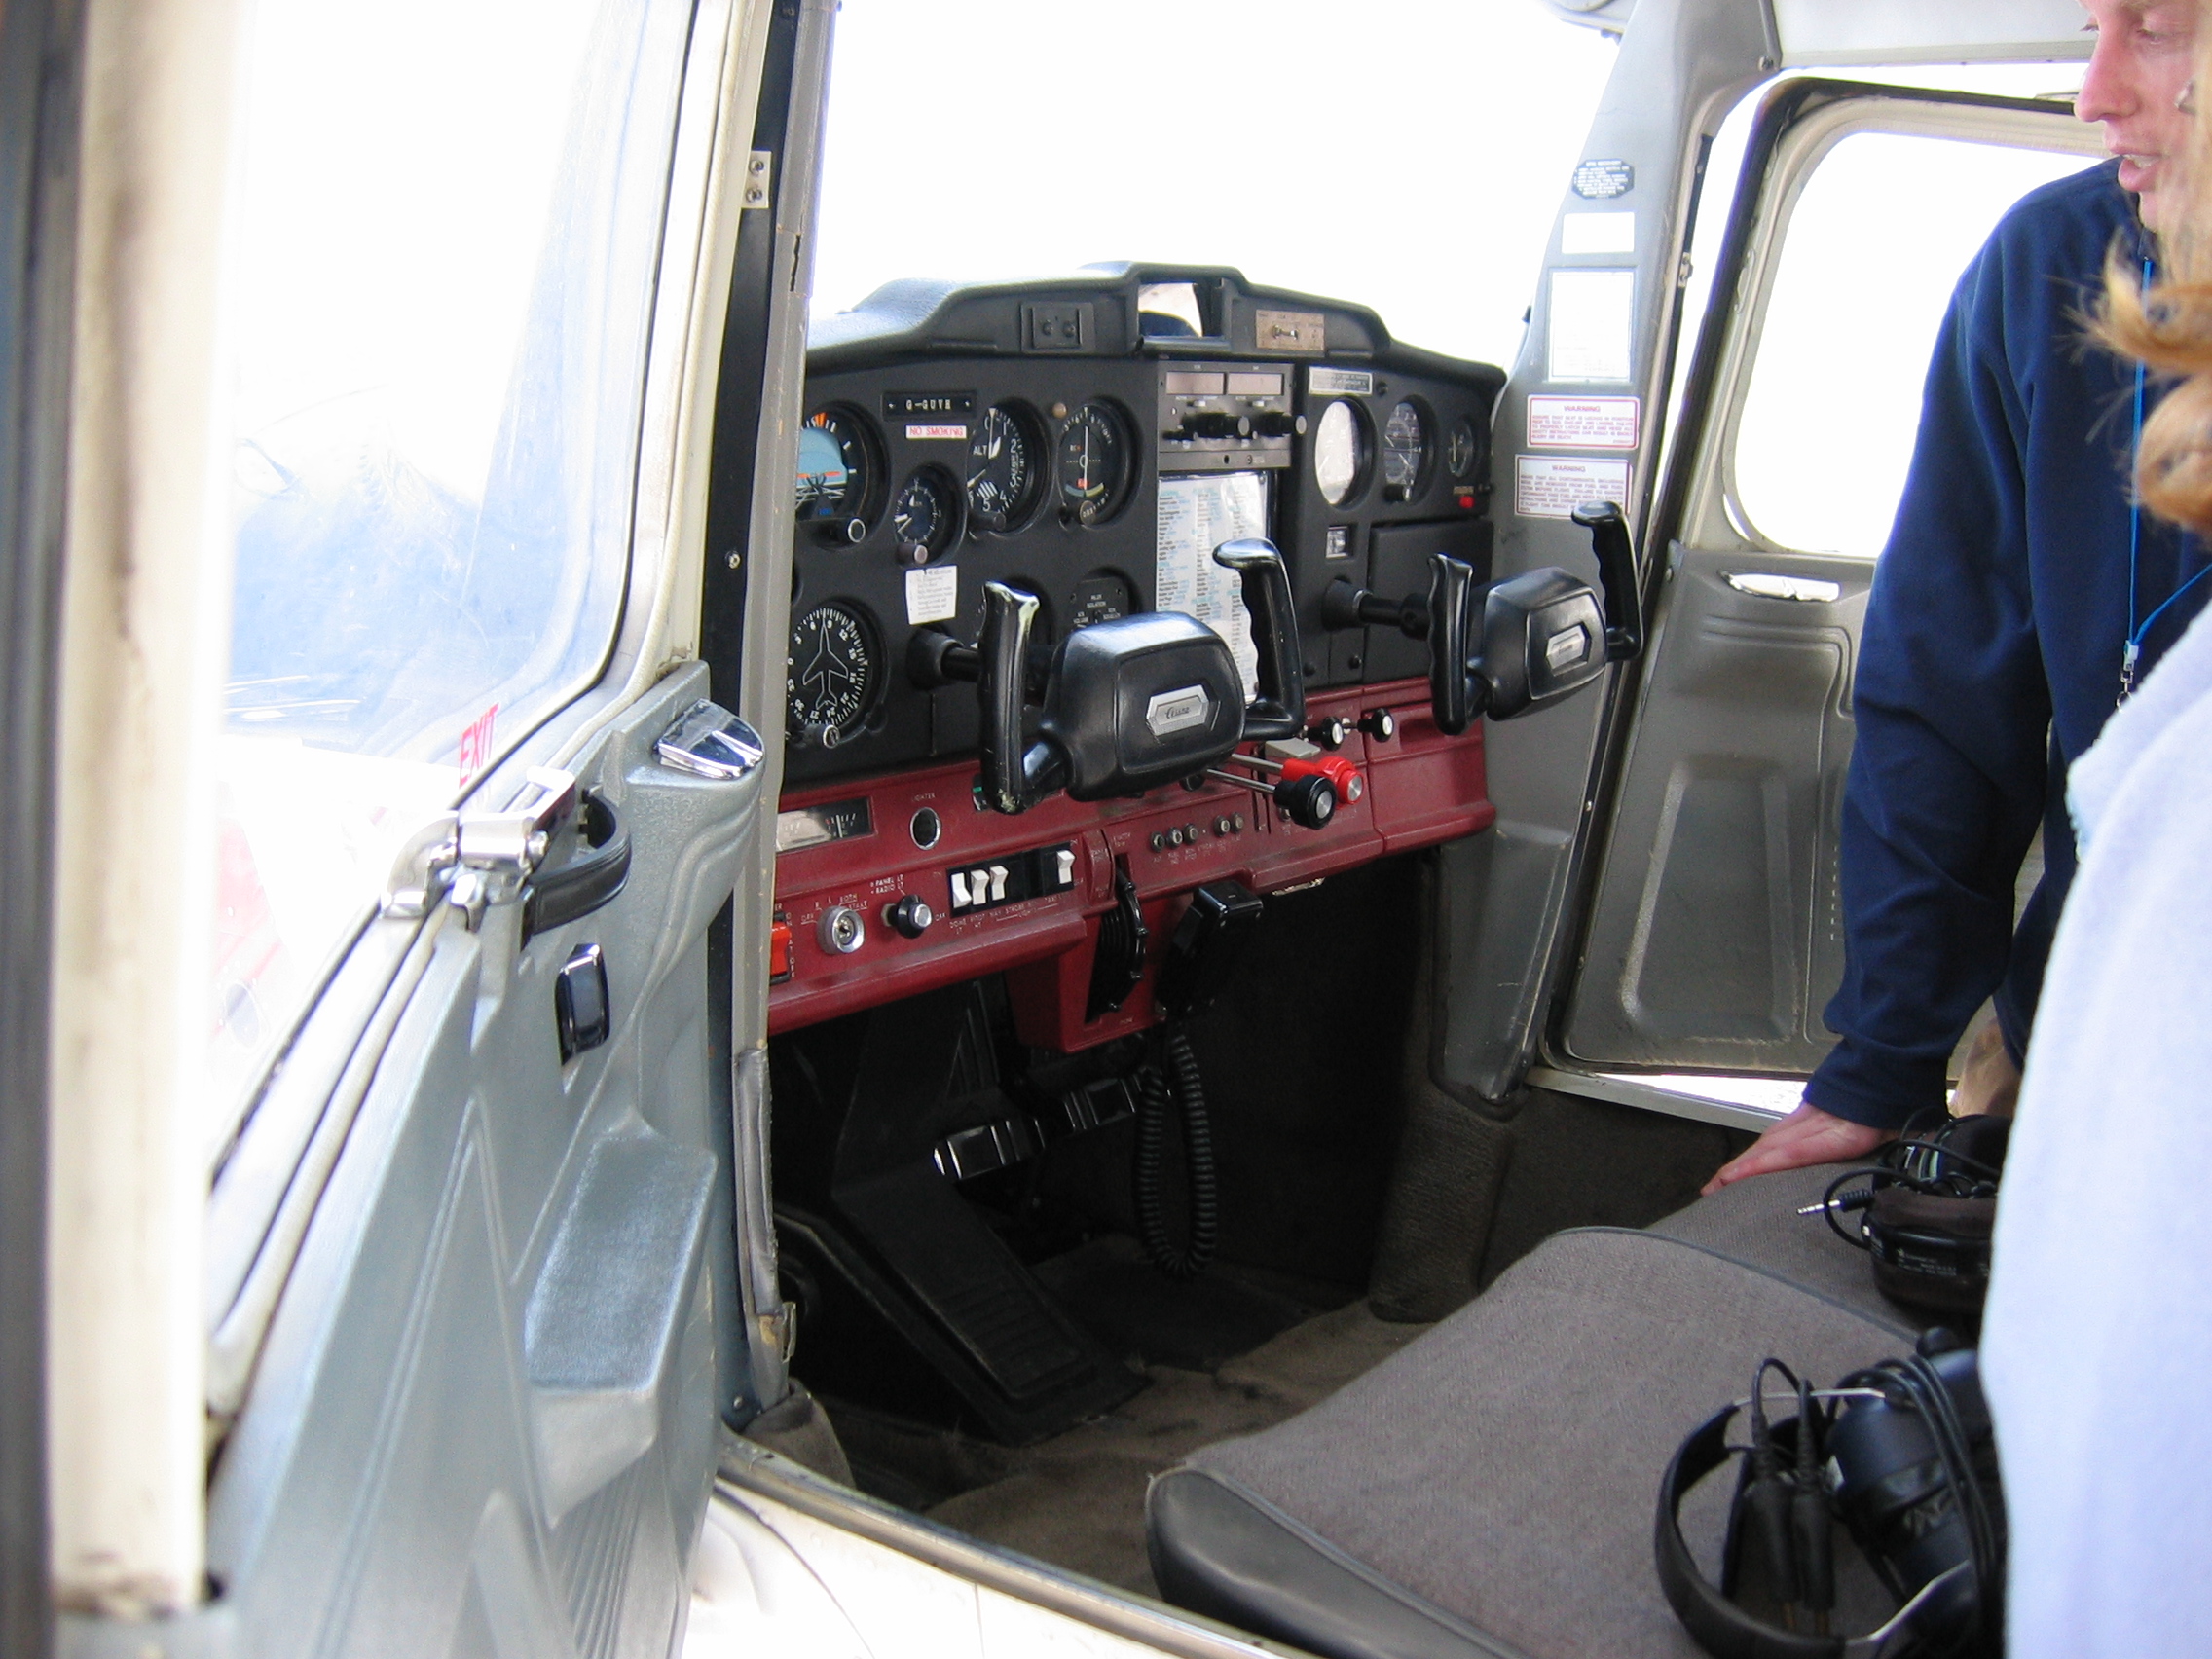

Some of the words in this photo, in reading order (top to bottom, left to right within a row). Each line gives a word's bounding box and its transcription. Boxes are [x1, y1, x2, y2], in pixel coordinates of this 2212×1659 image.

[909, 426, 922, 435] NO
[926, 426, 963, 436] SMOKING
[973, 445, 988, 456] ALT
[1010, 438, 1017, 453] 2
[999, 490, 1007, 500] 4
[982, 498, 991, 512] 5
[459, 701, 499, 789] EXIT
[876, 877, 894, 886] PANEL
[876, 884, 896, 894] RADIO
[839, 893, 858, 903] BOTH
